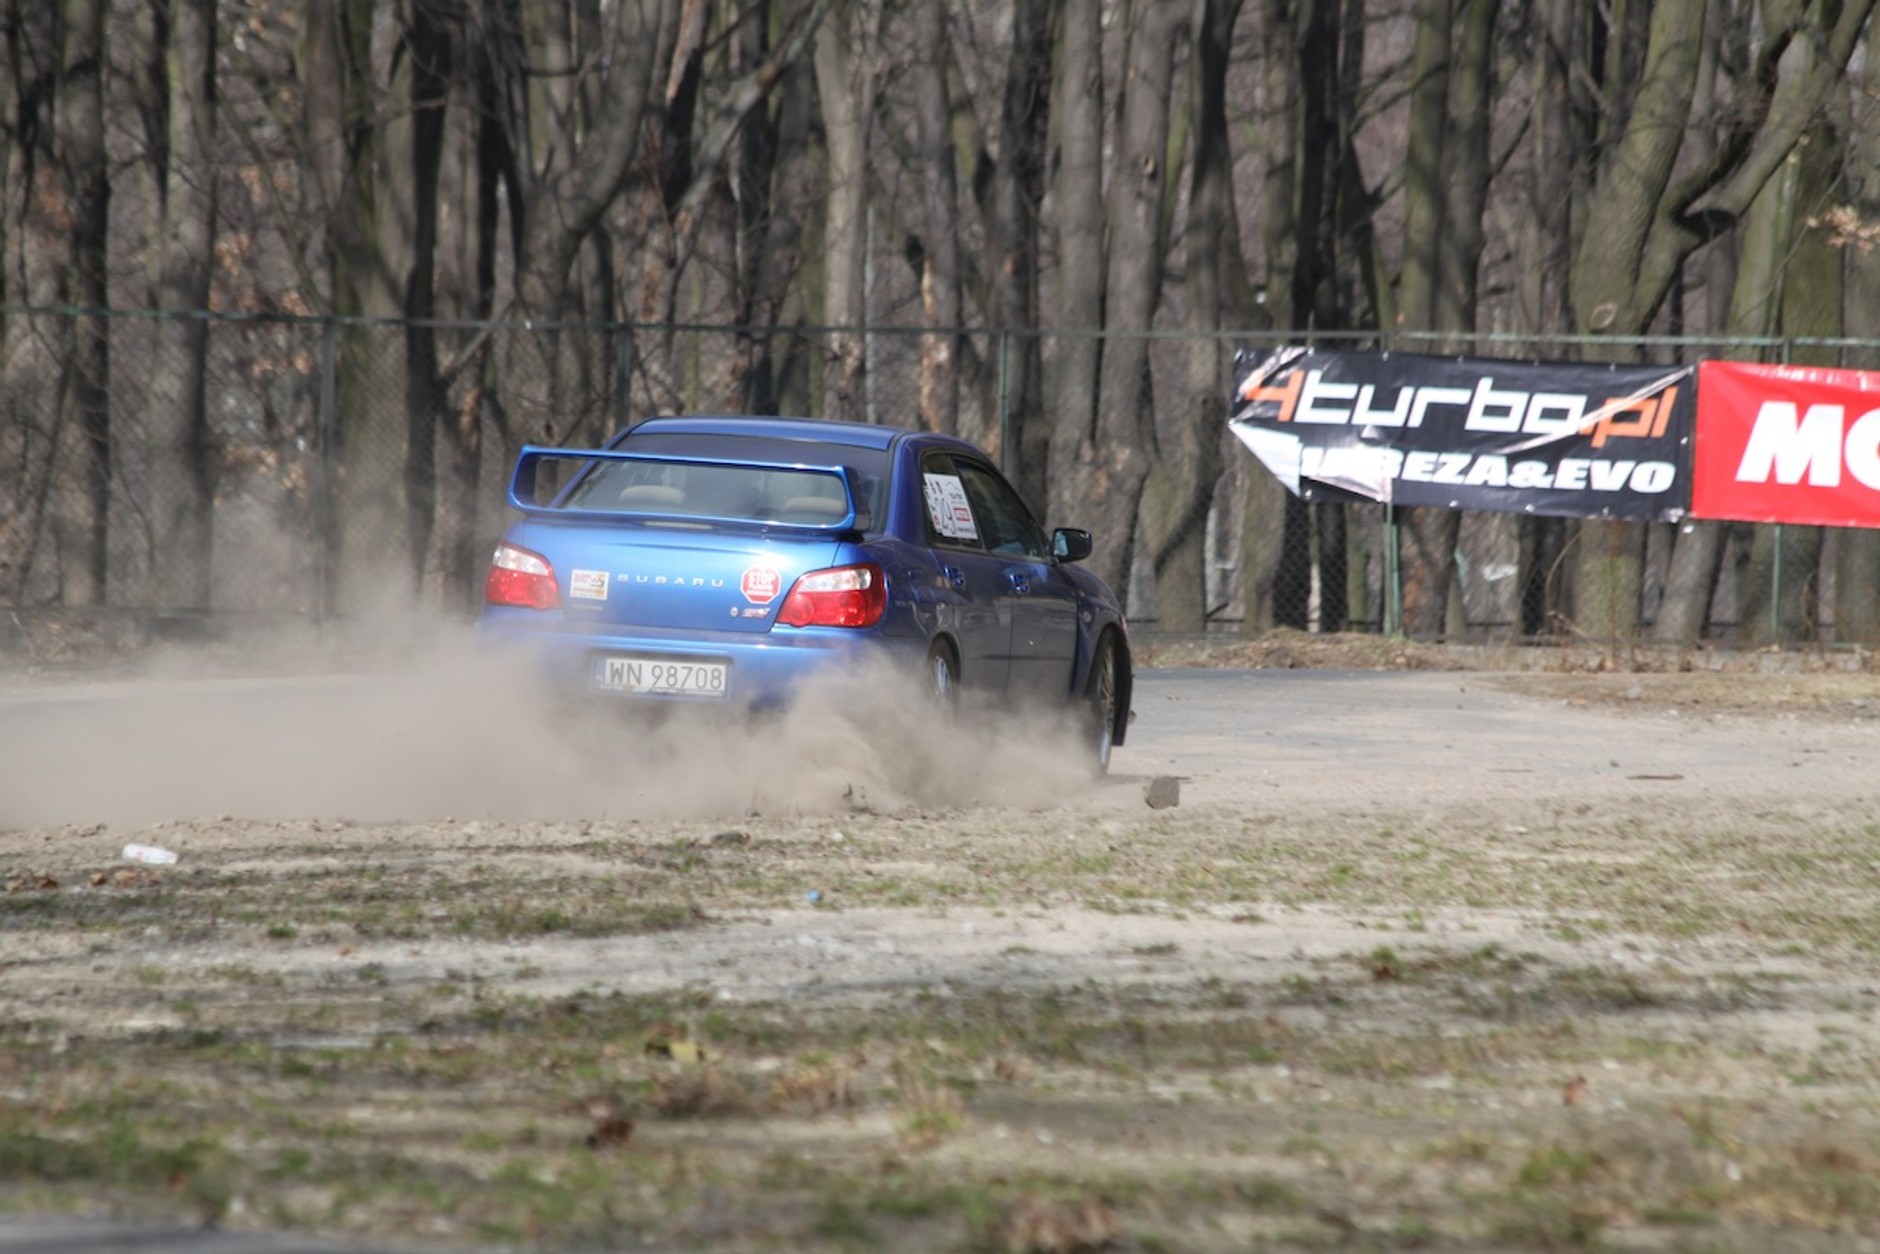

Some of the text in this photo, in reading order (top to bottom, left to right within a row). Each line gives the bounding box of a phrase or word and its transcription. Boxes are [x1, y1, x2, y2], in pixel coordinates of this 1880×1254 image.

[617, 574, 724, 588] SUBARU
[610, 662, 722, 690] WN 98708
